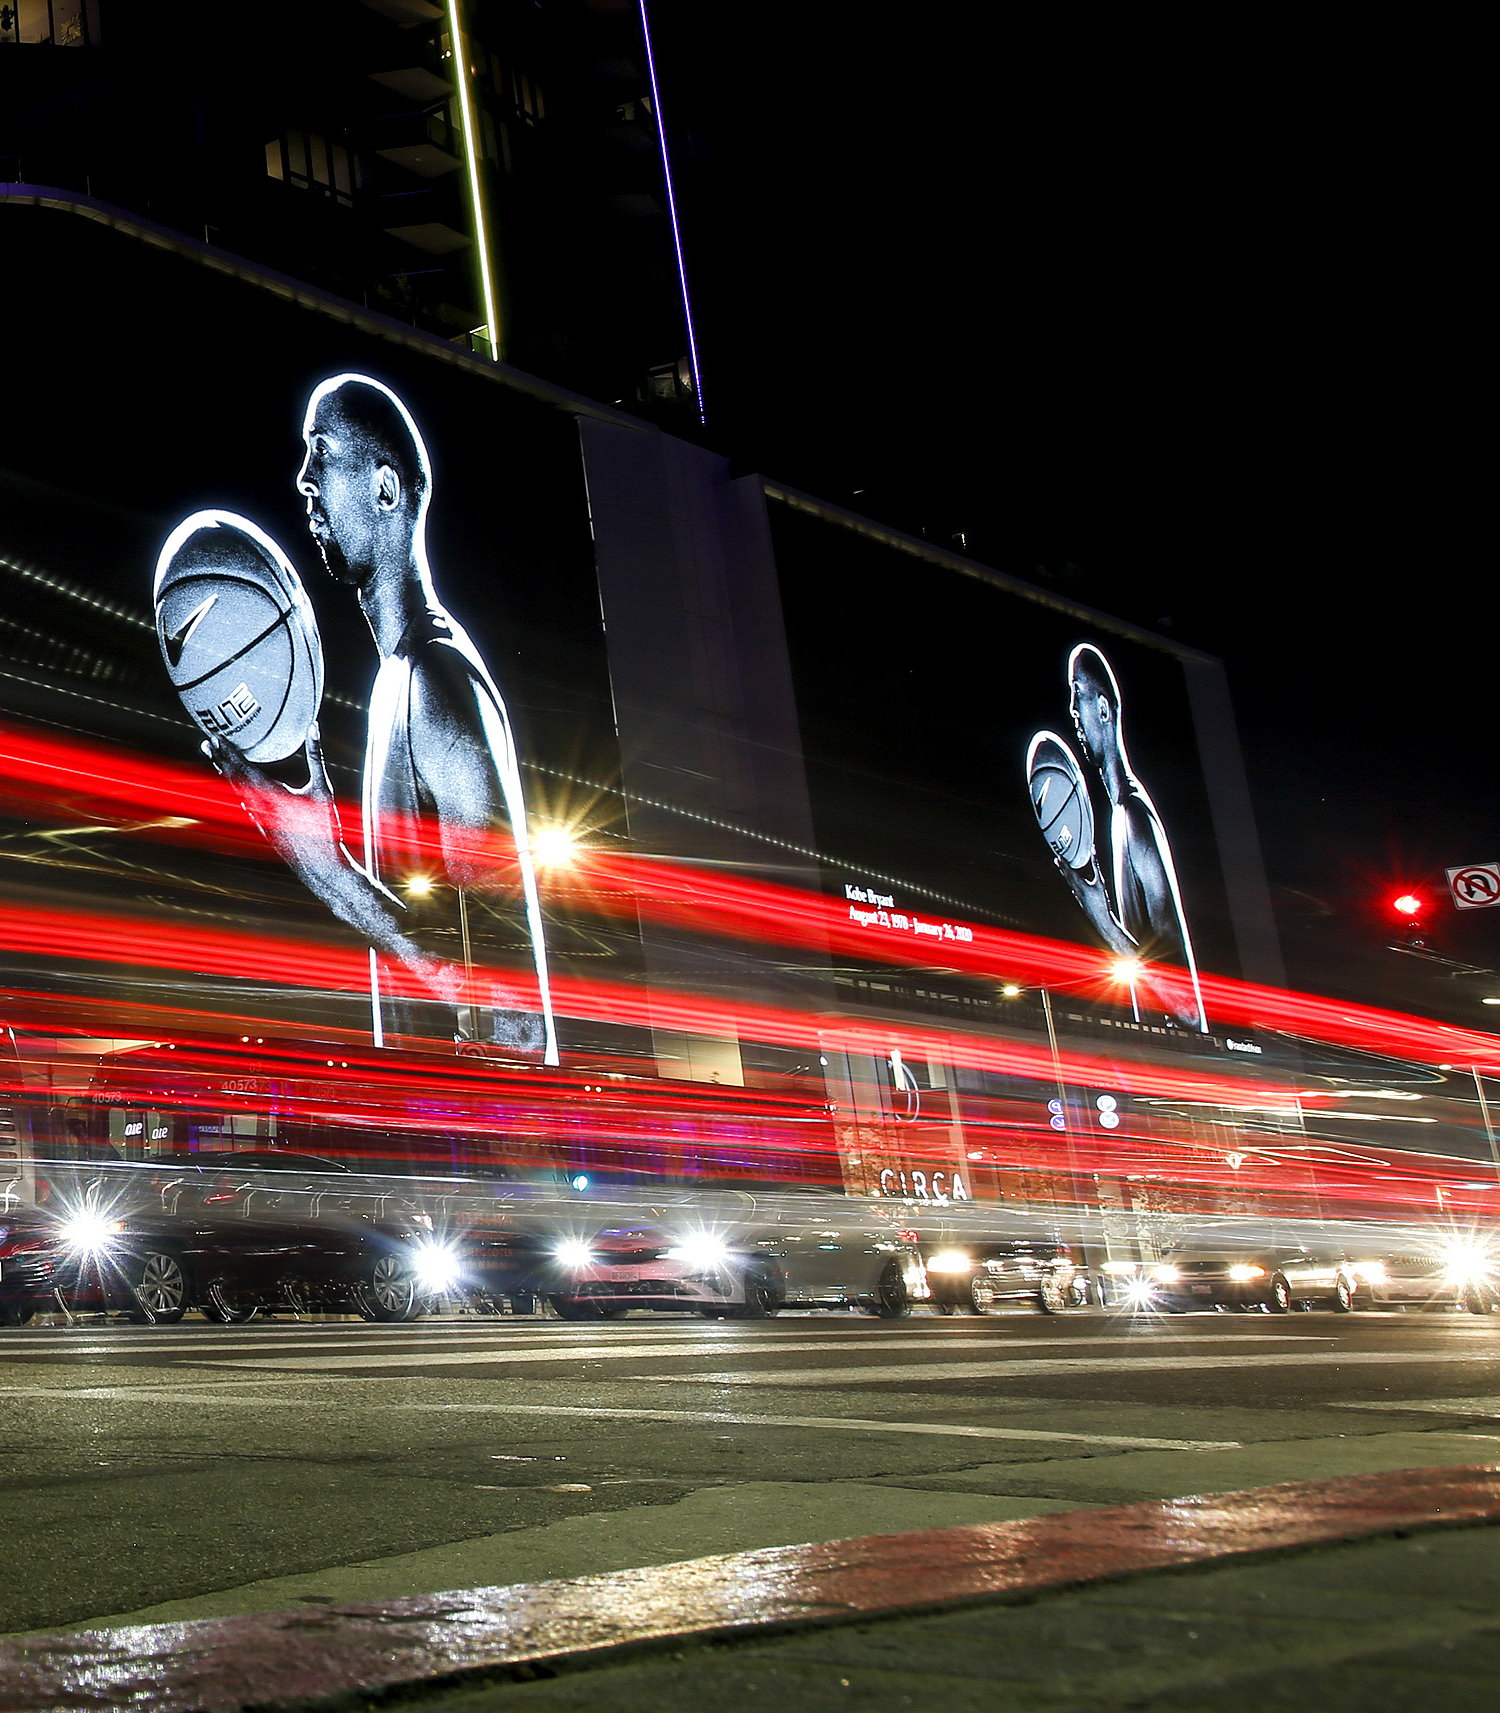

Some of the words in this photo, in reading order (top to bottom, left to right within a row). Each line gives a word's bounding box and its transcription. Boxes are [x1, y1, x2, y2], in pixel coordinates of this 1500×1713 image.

[844, 884, 867, 902] Kobe
[866, 888, 895, 909] Bryant
[849, 905, 878, 927] August
[913, 917, 943, 941] January
[221, 1079, 258, 1091] 40573
[880, 1168, 968, 1201] CIRCA
